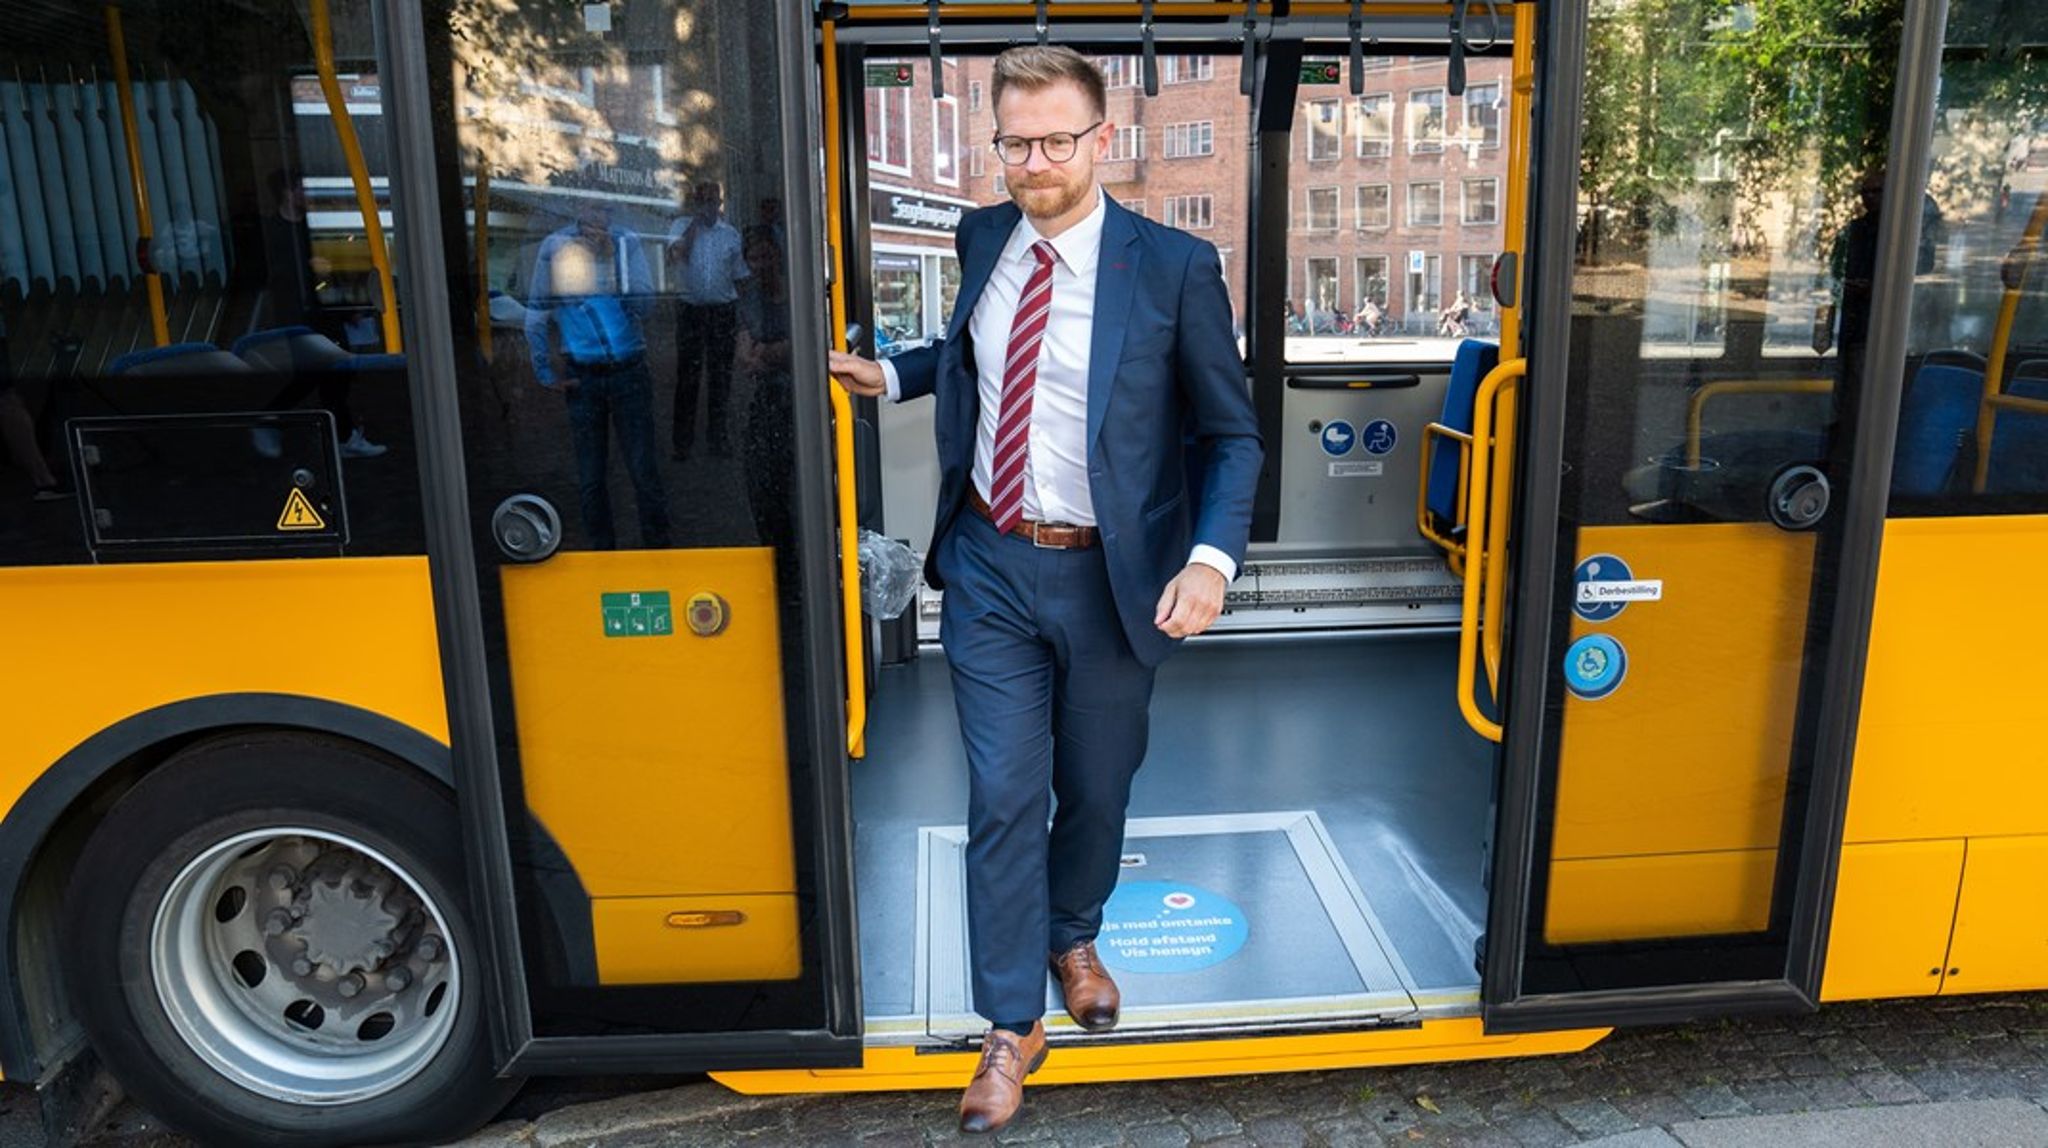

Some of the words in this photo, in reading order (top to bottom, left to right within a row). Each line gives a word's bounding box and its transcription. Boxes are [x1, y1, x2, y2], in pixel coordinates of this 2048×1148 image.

[1102, 919, 1120, 932] js
[1122, 918, 1159, 930] med
[1160, 916, 1234, 928] omtanke
[1109, 936, 1150, 948] Hold
[1151, 933, 1217, 946] afstand
[1120, 948, 1148, 958] Vis
[1149, 945, 1213, 957] hensyn
